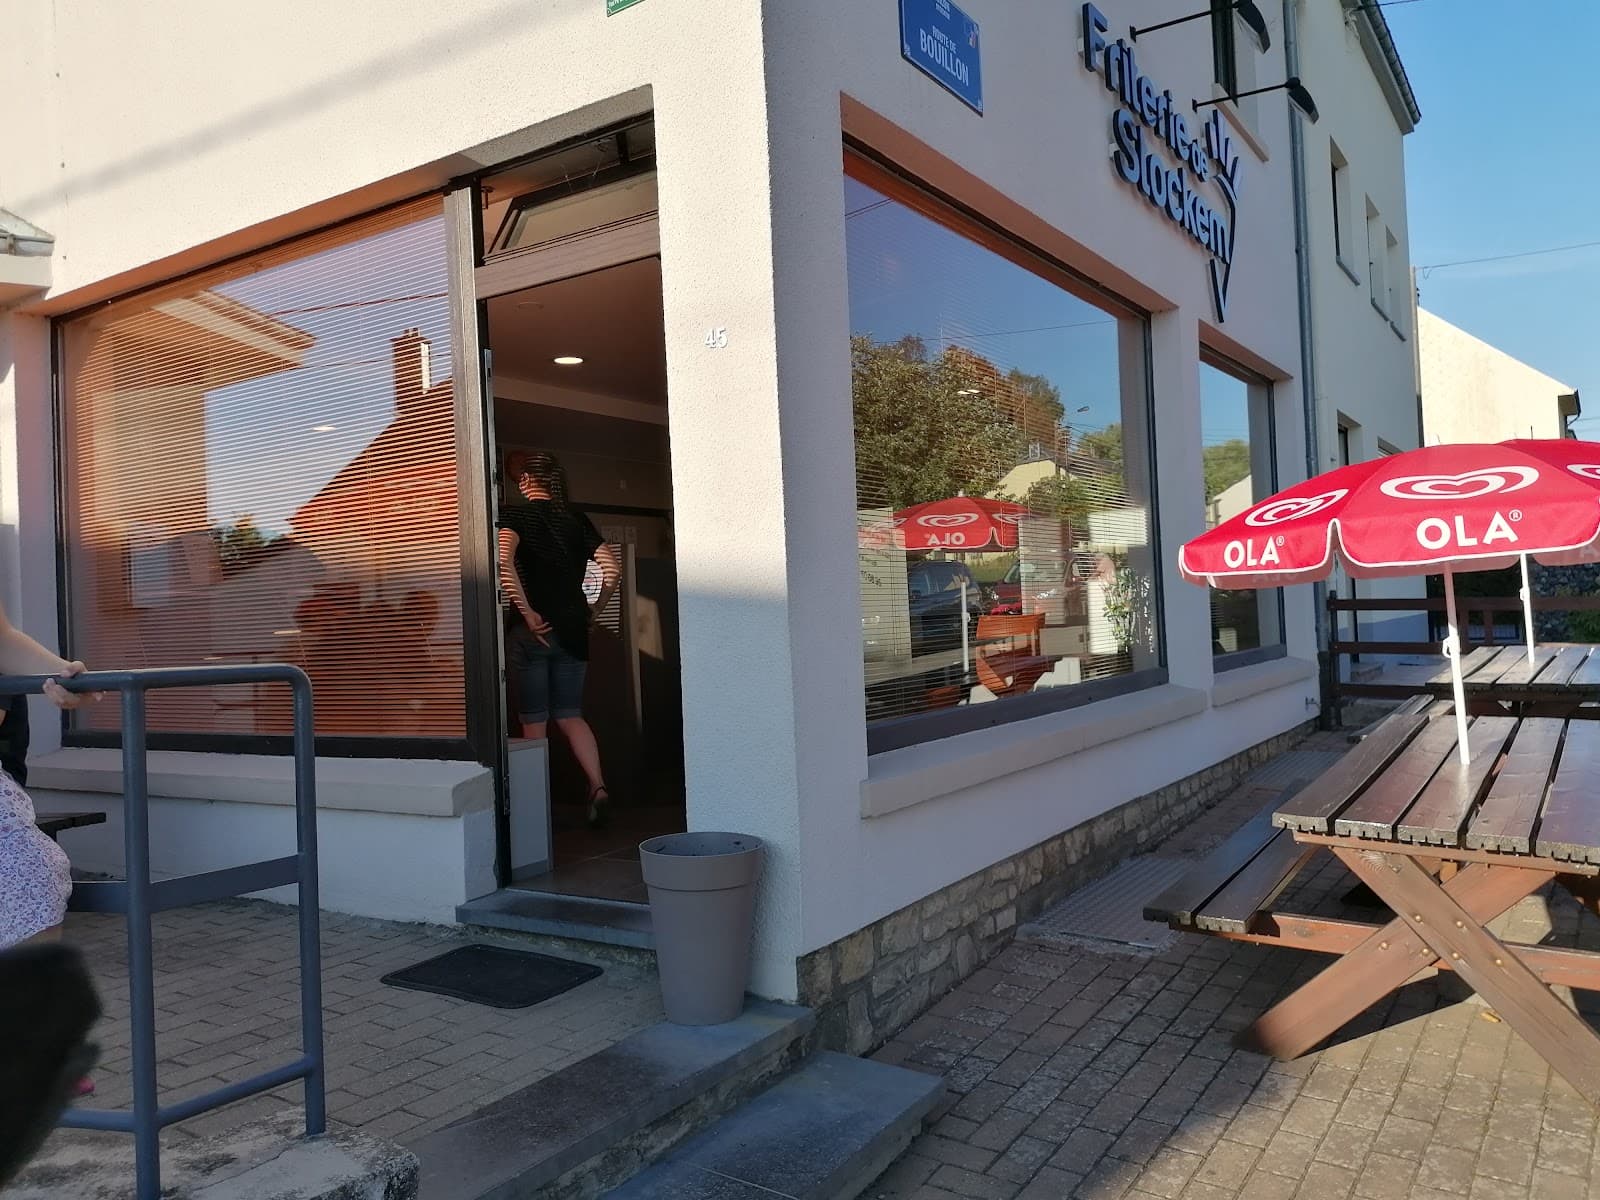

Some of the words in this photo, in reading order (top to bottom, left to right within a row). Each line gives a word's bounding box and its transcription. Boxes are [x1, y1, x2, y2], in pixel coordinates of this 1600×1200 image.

[919, 28, 969, 87] BOUILLON
[932, 25, 949, 49] ROUTE
[949, 39, 957, 54] DE
[1082, 1, 1191, 161] Friterie
[1189, 139, 1209, 183] de
[1112, 108, 1230, 265] Stockem
[704, 328, 728, 349] 45
